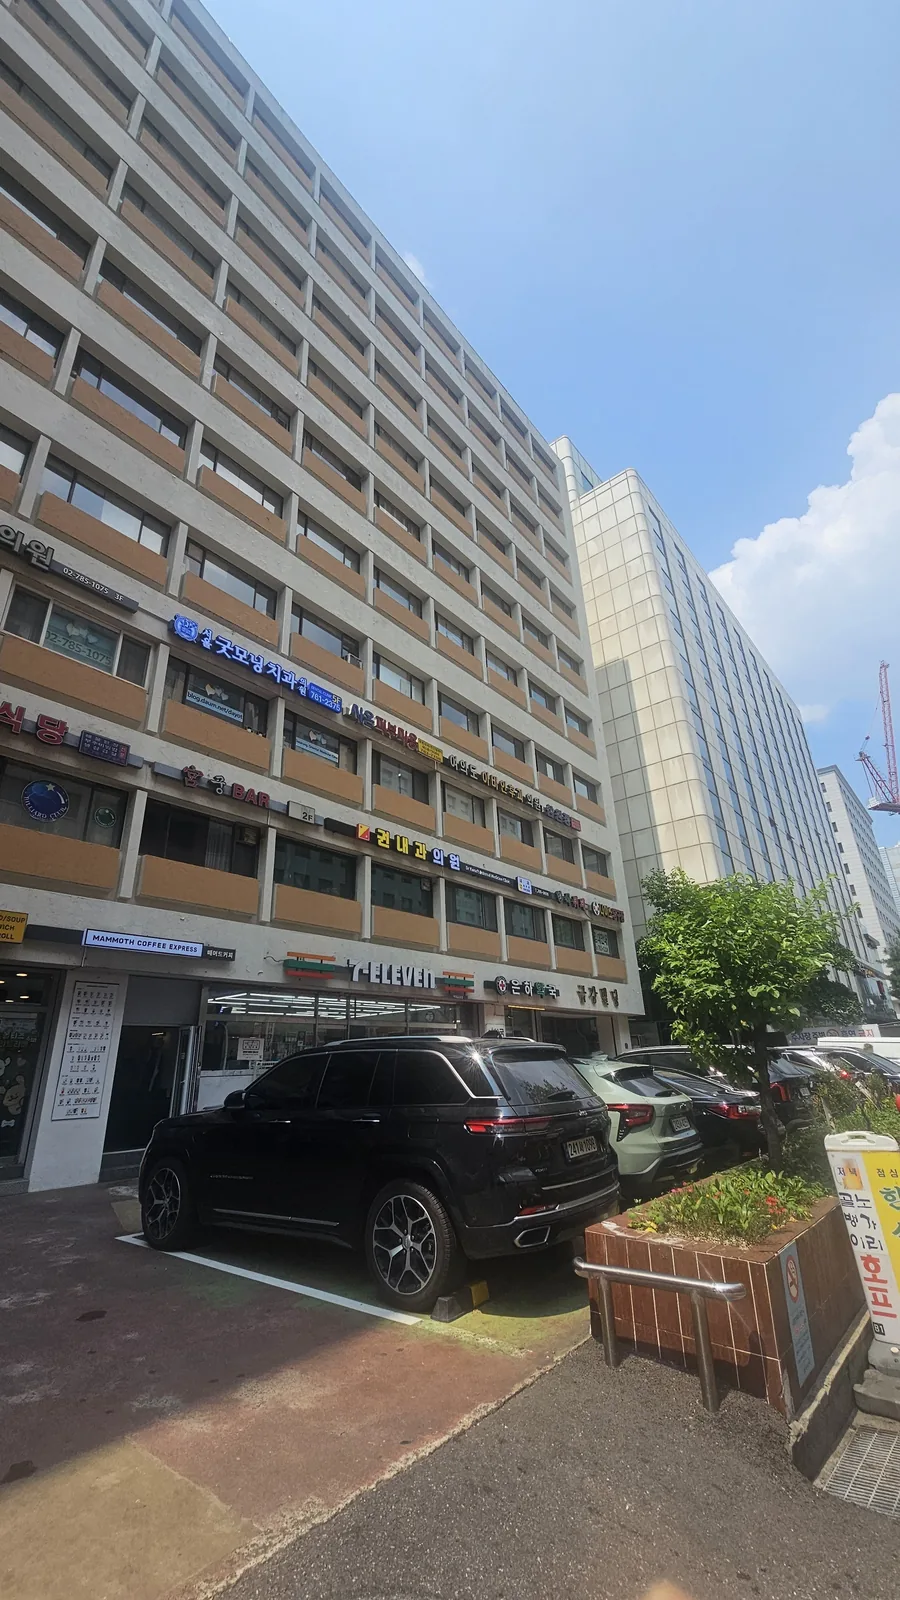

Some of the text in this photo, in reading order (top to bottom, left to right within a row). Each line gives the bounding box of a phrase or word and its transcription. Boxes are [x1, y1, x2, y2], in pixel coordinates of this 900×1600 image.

[0, 525, 55, 572] 의원
[63, 567, 124, 601] 02-785-1075 3F
[332, 694, 342, 705] 5F
[0, 701, 69, 745] 식당
[449, 754, 478, 780] 여의도
[232, 783, 270, 808] BAR
[302, 811, 313, 821] 2F
[92, 934, 198, 953] MAMMOTH COFFEE EXPRESS
[511, 978, 558, 1000] 은하약국
[876, 1168, 899, 1178] 점심
[860, 1254, 898, 1319] 호프
